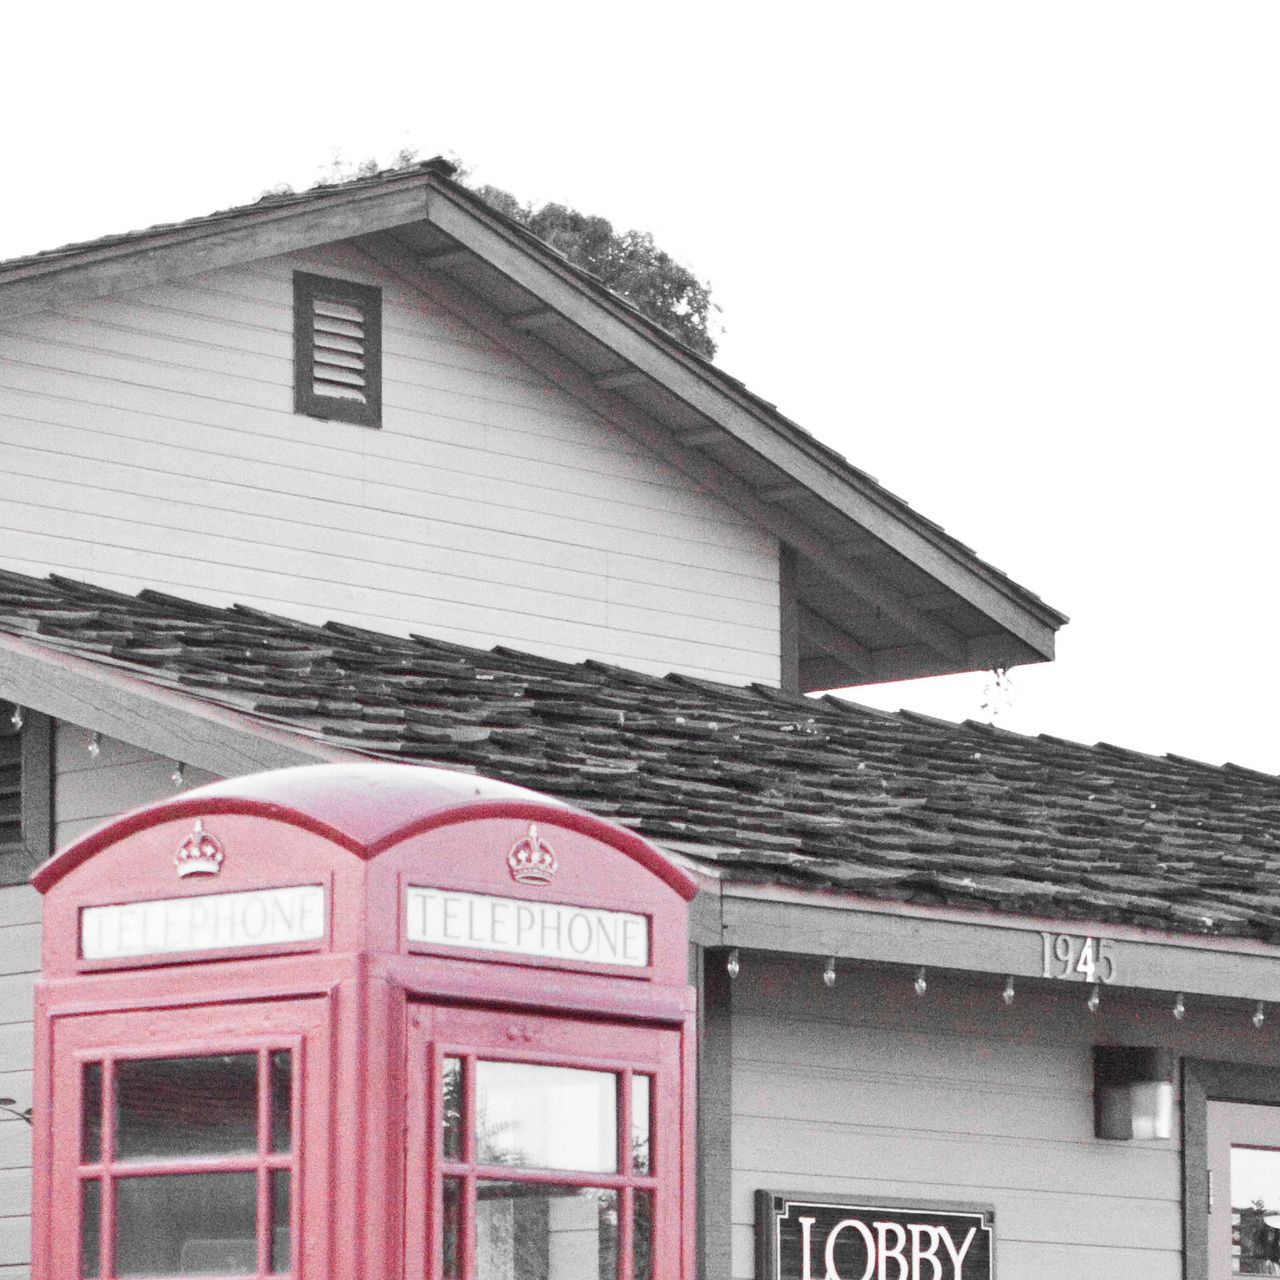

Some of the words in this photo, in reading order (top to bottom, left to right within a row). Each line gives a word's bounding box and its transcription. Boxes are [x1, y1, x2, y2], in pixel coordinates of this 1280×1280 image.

[91, 893, 319, 951] TELEPHONE
[414, 893, 641, 960] TELEPHONE
[1040, 931, 1117, 984] 1945
